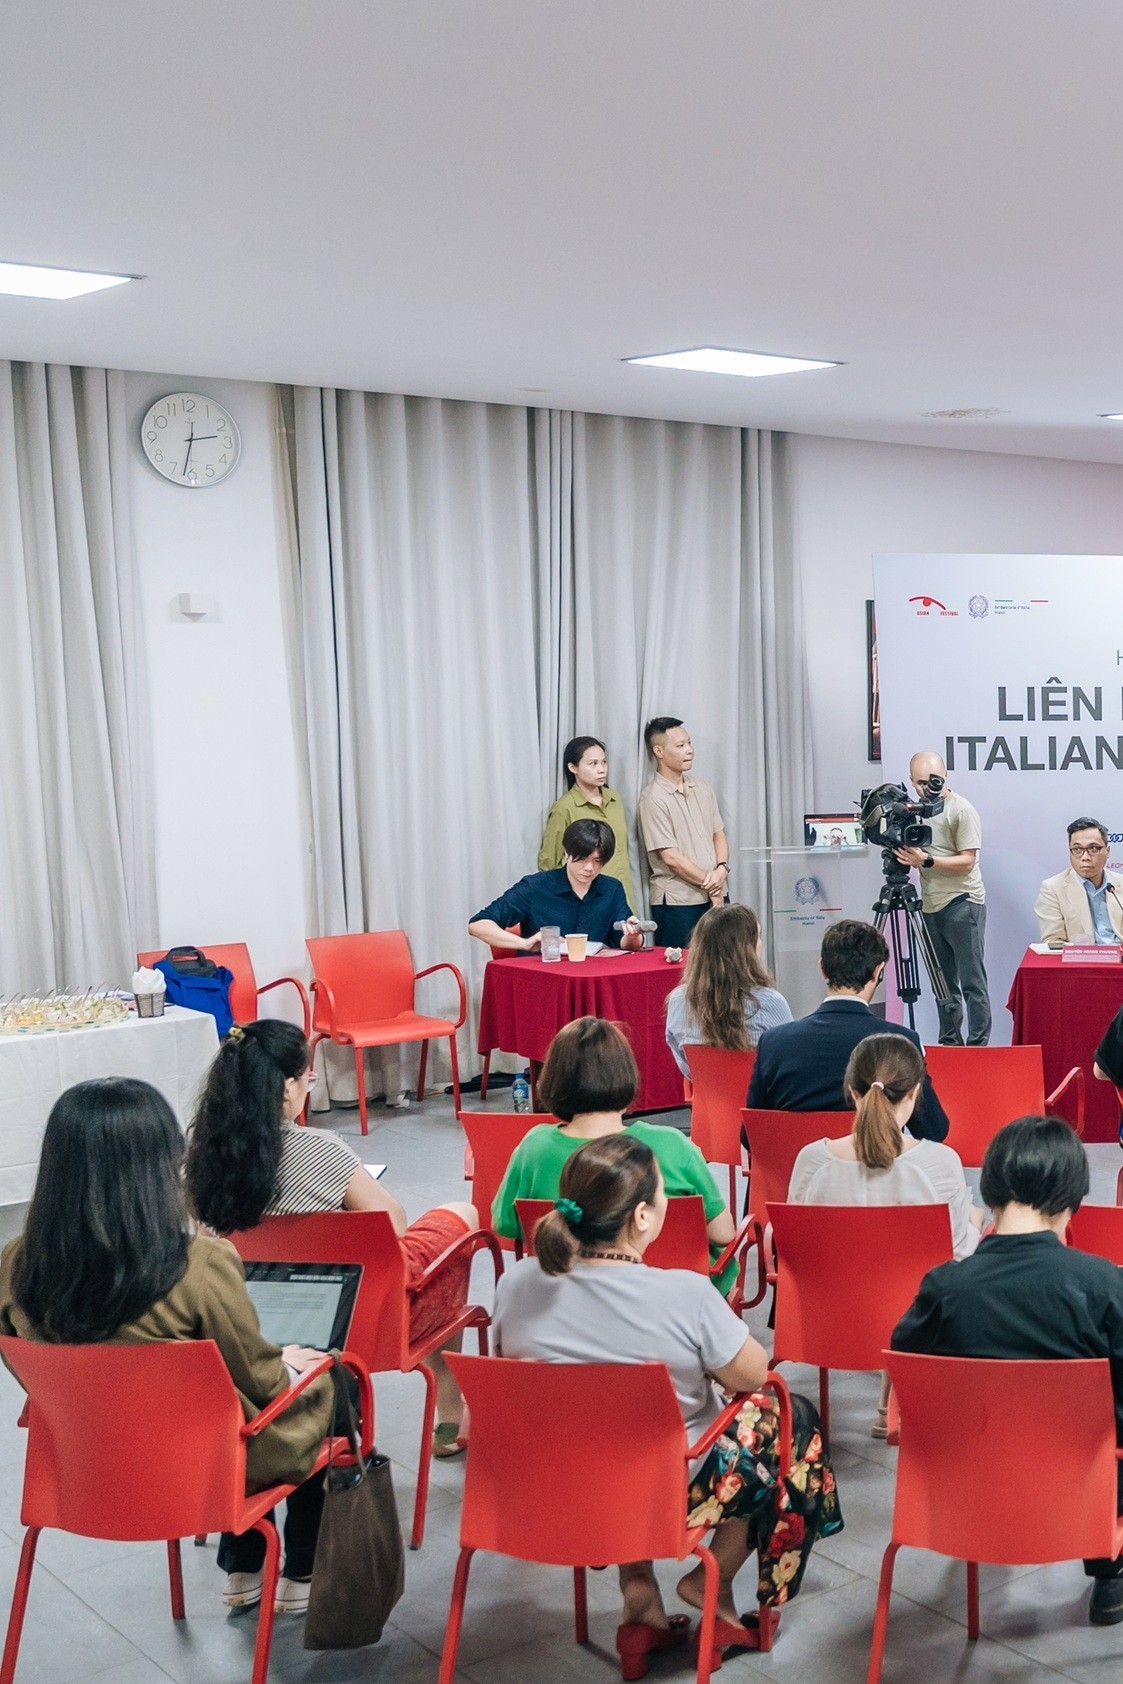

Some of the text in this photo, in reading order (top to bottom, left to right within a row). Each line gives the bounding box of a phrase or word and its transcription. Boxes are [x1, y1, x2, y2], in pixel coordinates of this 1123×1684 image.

[167, 403, 176, 416] 11
[182, 399, 195, 413] 12
[205, 405, 209, 418] 1
[153, 415, 168, 429] 10
[216, 419, 226, 431] 2
[147, 431, 157, 444] 9
[223, 436, 233, 449] 3
[154, 449, 163, 462] 8
[218, 453, 227, 465] 4
[169, 461, 177, 474] 7
[205, 464, 215, 477] 5
[187, 468, 197, 481] 6
[998, 676, 1103, 721] LIÊN
